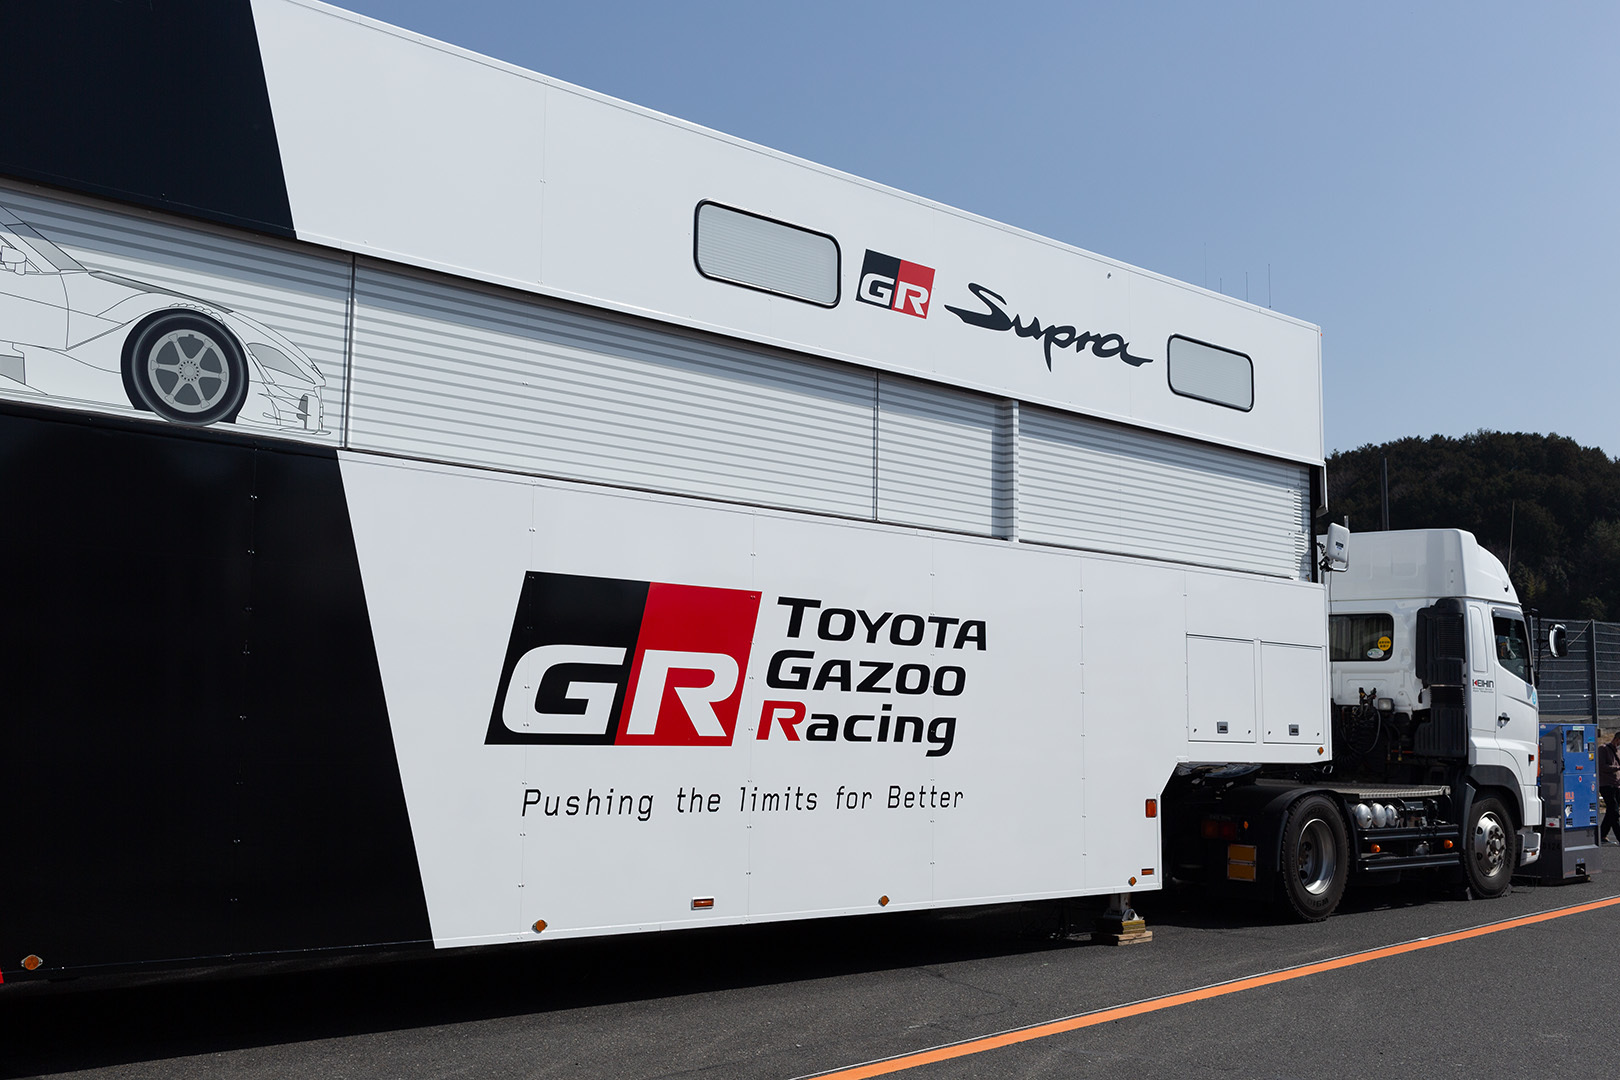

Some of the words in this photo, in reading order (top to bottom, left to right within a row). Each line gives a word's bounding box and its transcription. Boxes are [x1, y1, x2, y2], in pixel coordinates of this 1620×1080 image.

[859, 272, 930, 317] GR
[943, 282, 1154, 373] Supra
[777, 596, 987, 652] TOYOTA
[501, 643, 740, 737] GR
[766, 649, 967, 697] GAZOO
[756, 699, 957, 758] Racing
[521, 788, 654, 822] Pushing
[676, 786, 721, 814] the
[740, 786, 818, 812] limits
[836, 785, 873, 810] for
[887, 785, 964, 809] Better
